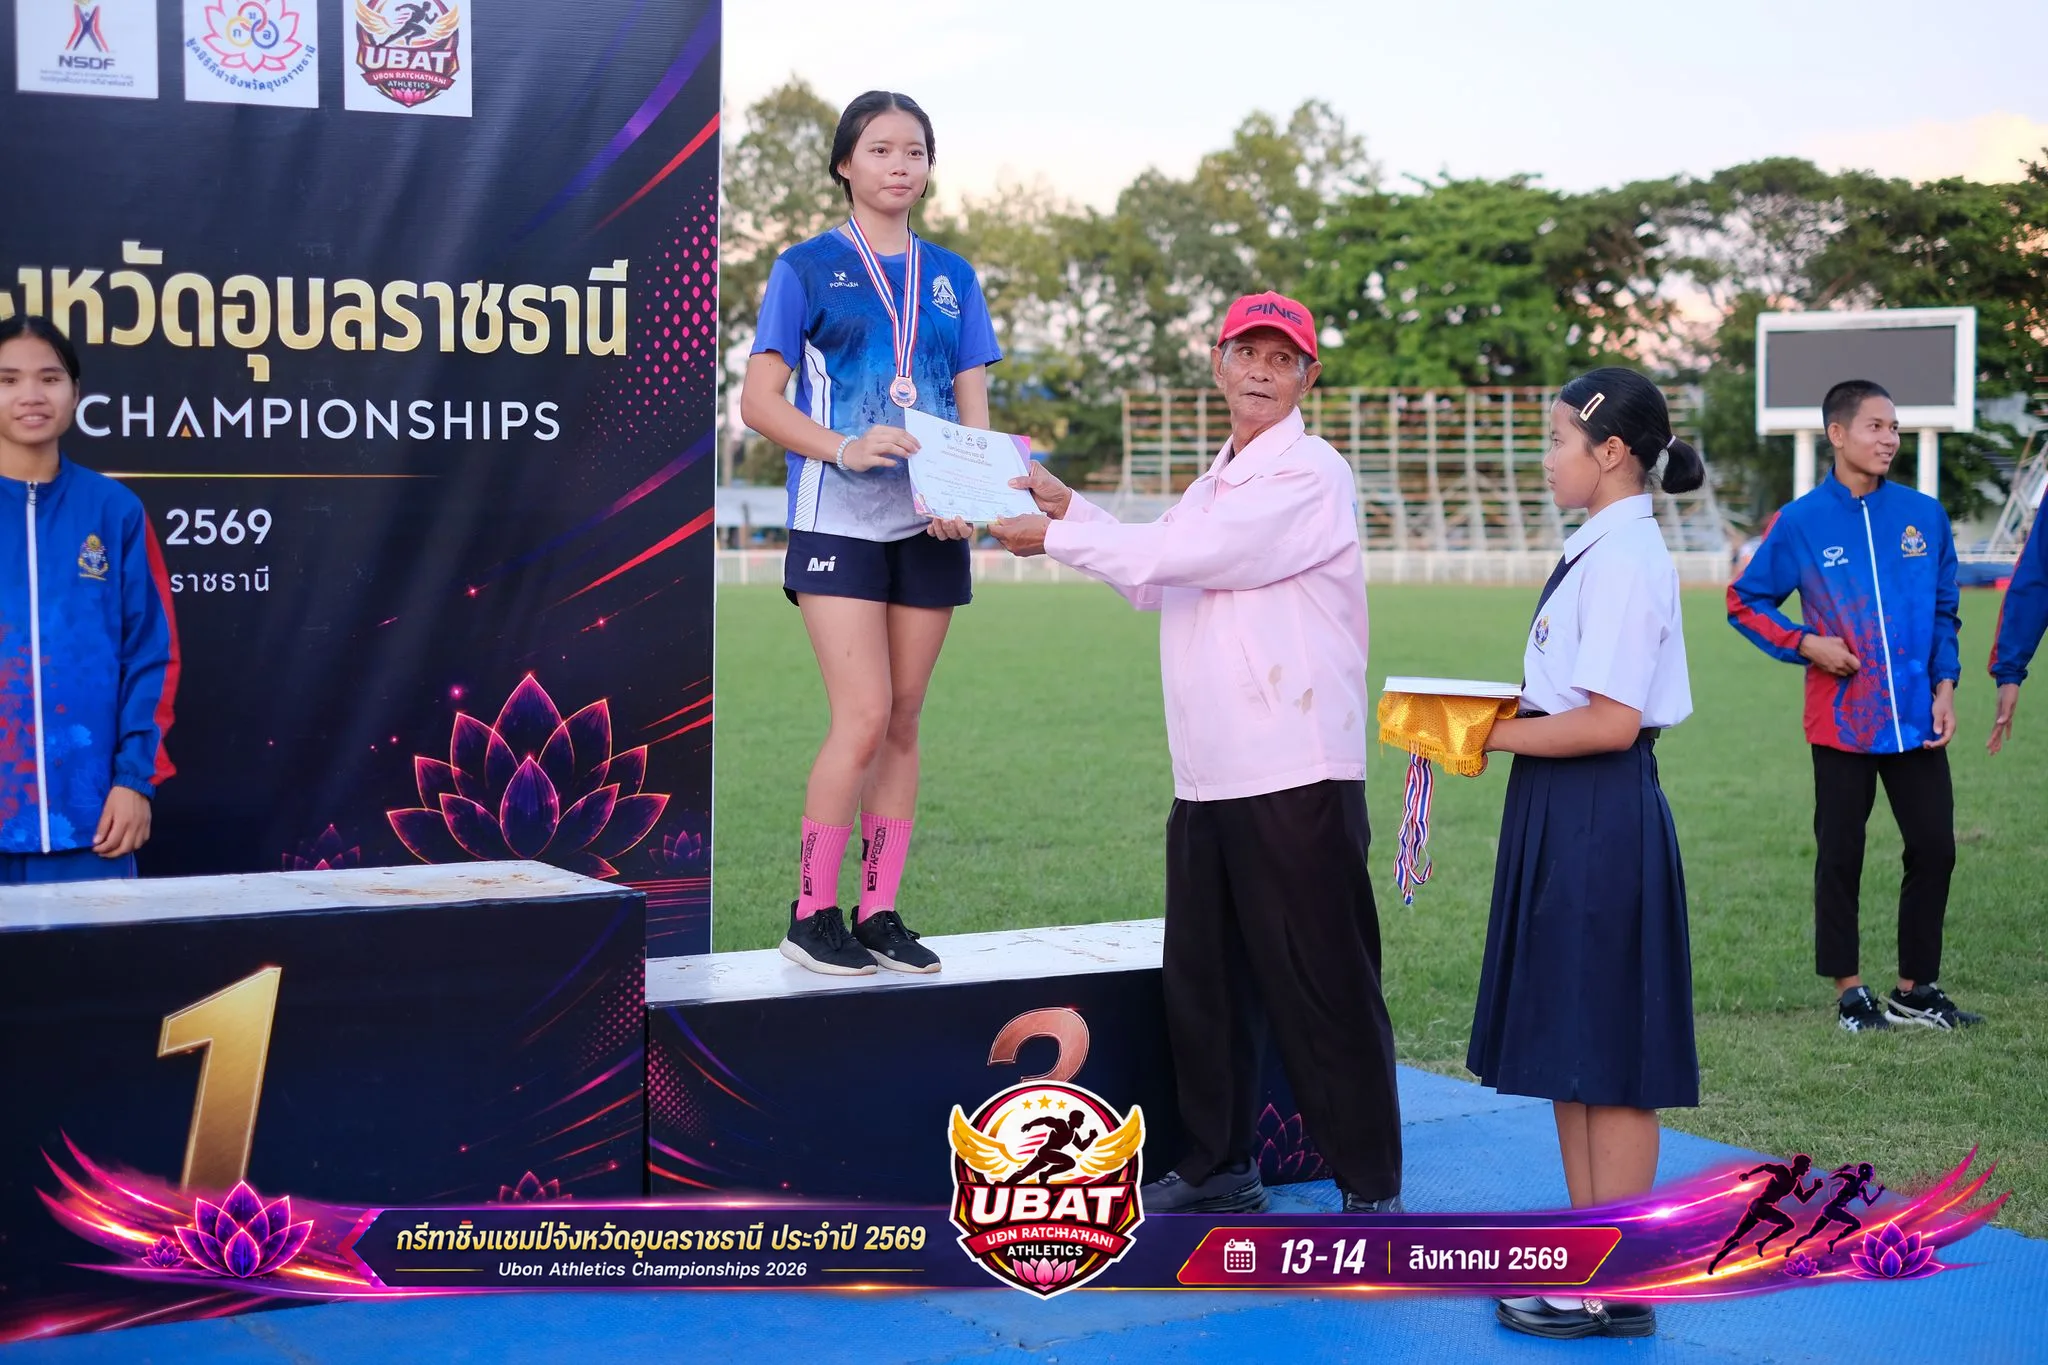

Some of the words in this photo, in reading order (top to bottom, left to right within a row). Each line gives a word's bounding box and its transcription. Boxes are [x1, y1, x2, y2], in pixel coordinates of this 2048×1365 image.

[58, 55, 116, 70] NSDF
[364, 46, 452, 74] UBAT
[387, 80, 430, 89] ATHLETICS
[1245, 302, 1303, 326] PING
[75, 394, 560, 441] CHAMPIONSHIPS
[166, 508, 272, 545] 2569
[807, 555, 837, 571] Ari
[157, 966, 282, 1196] 1
